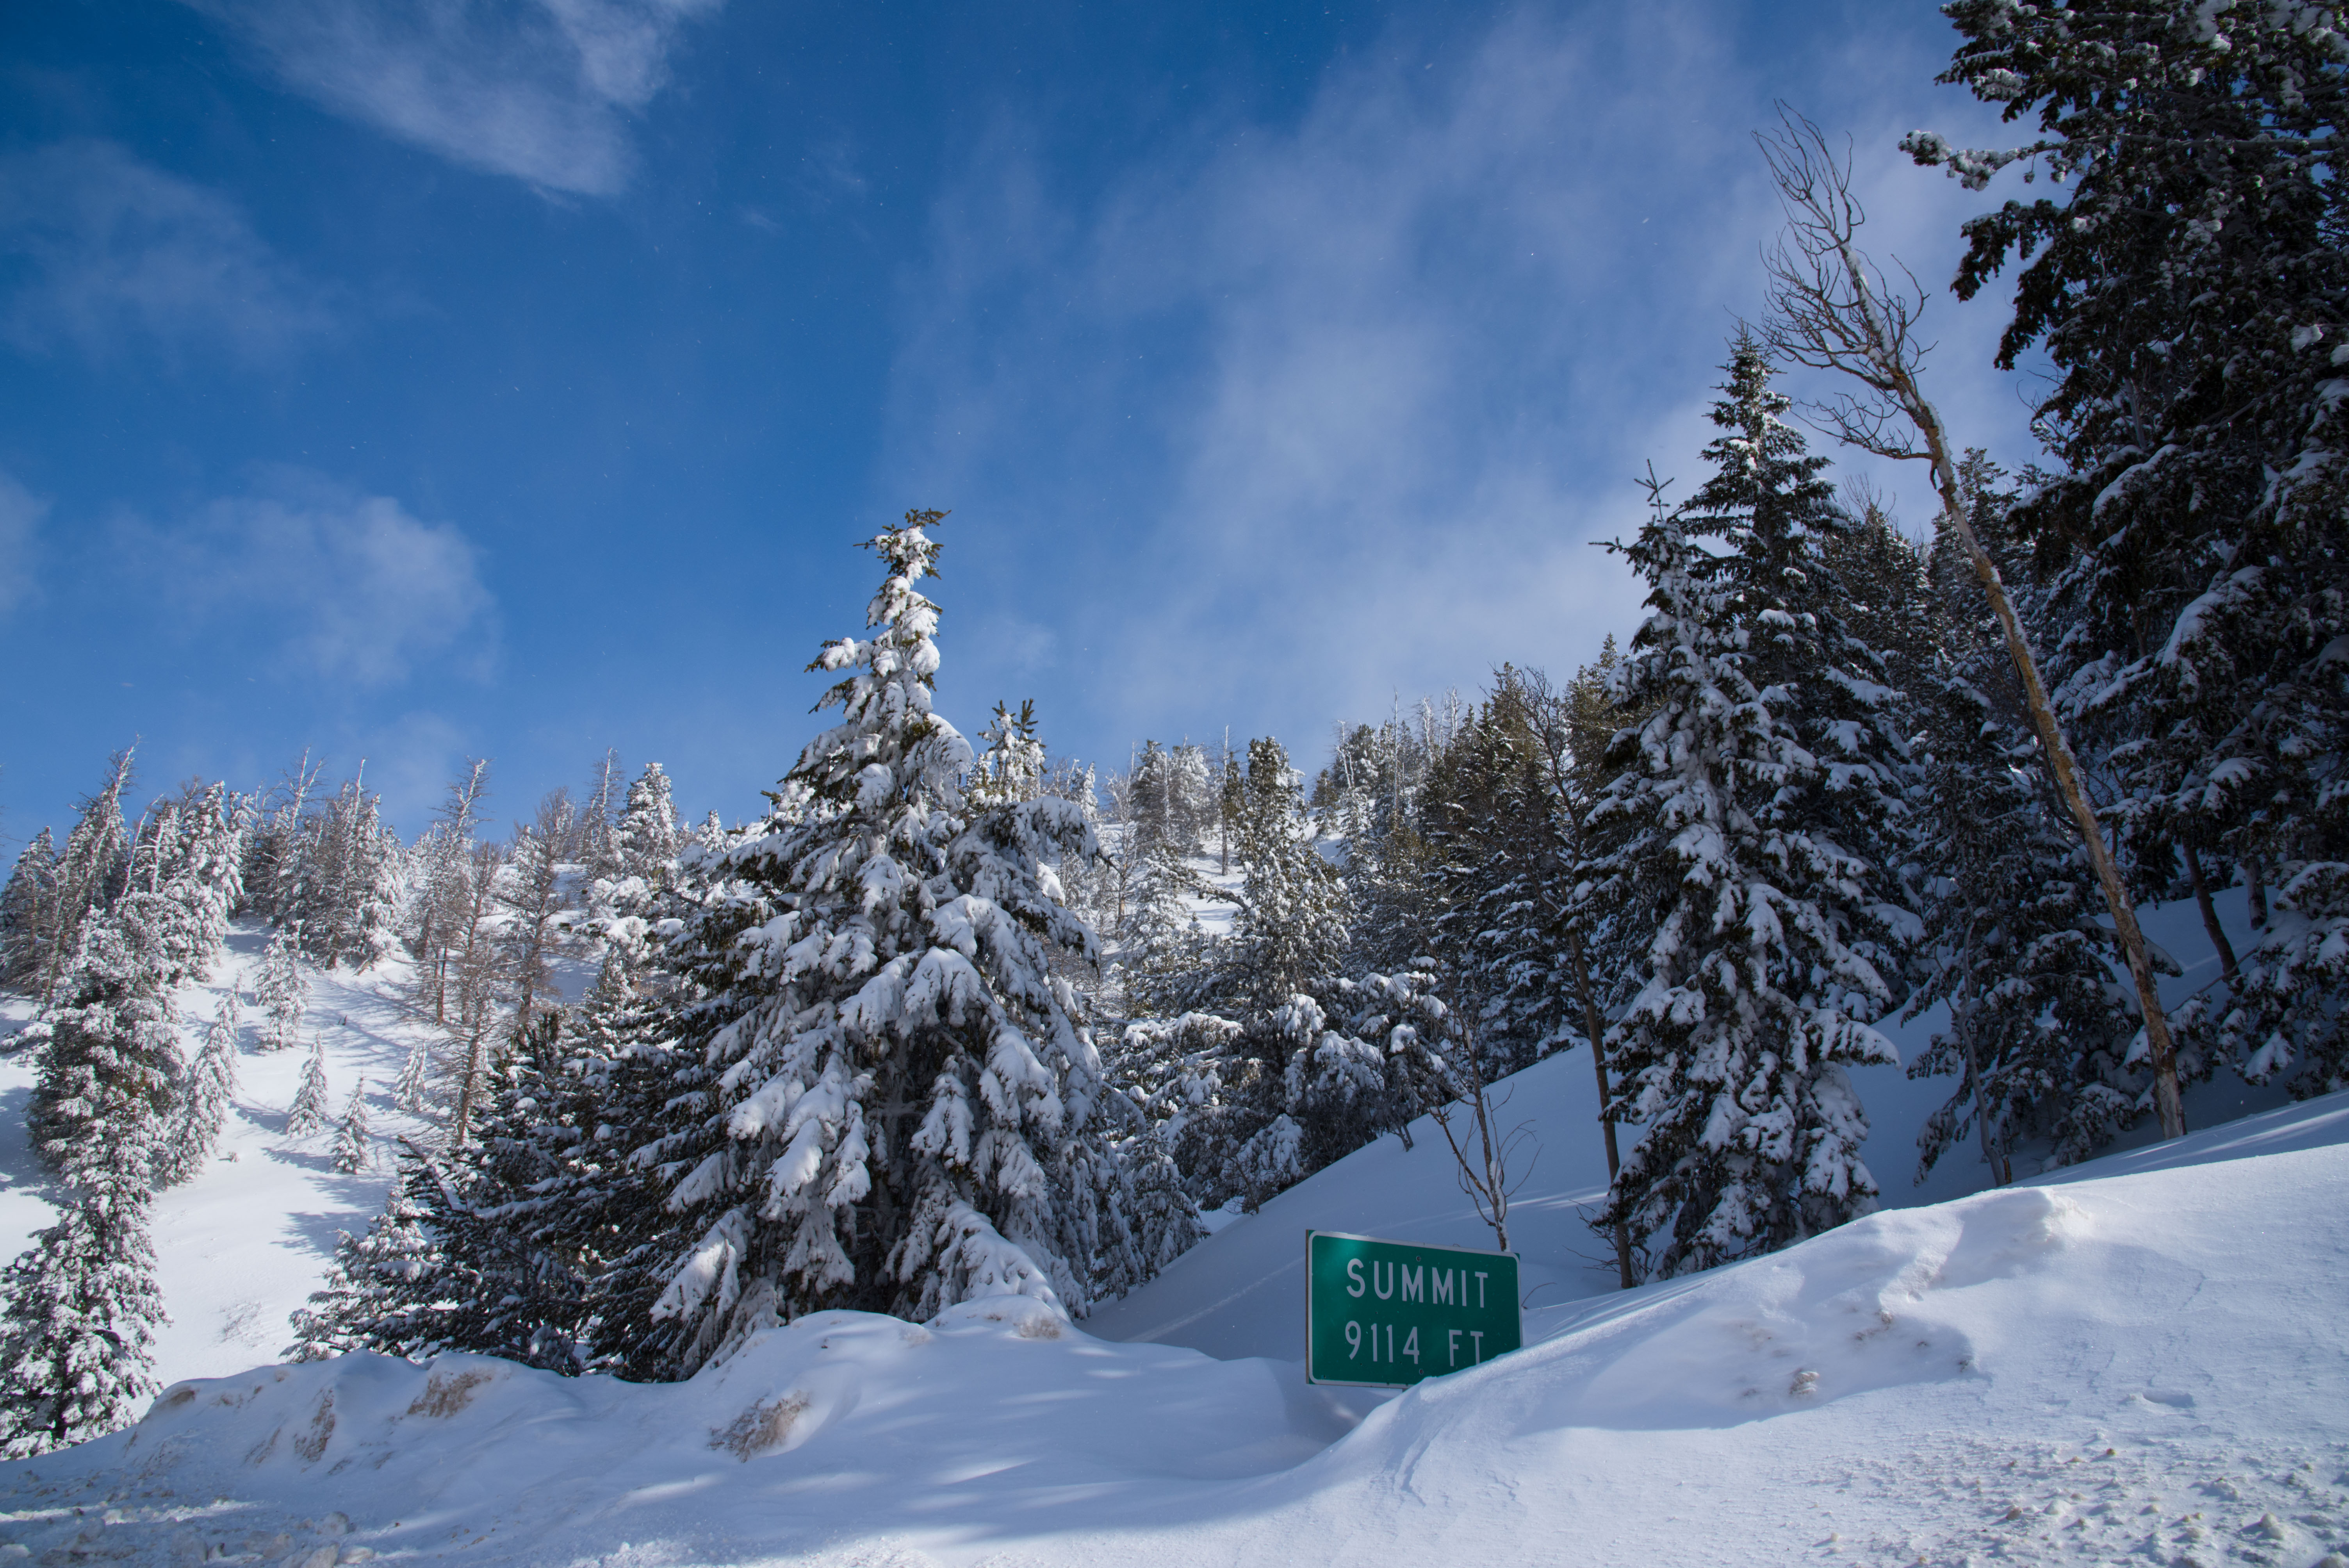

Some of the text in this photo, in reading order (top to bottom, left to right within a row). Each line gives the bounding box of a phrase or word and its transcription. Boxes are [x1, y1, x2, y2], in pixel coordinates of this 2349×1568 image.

[1346, 1258, 1488, 1308] SUMMIT
[1345, 1320, 1483, 1366] 9114 FT
